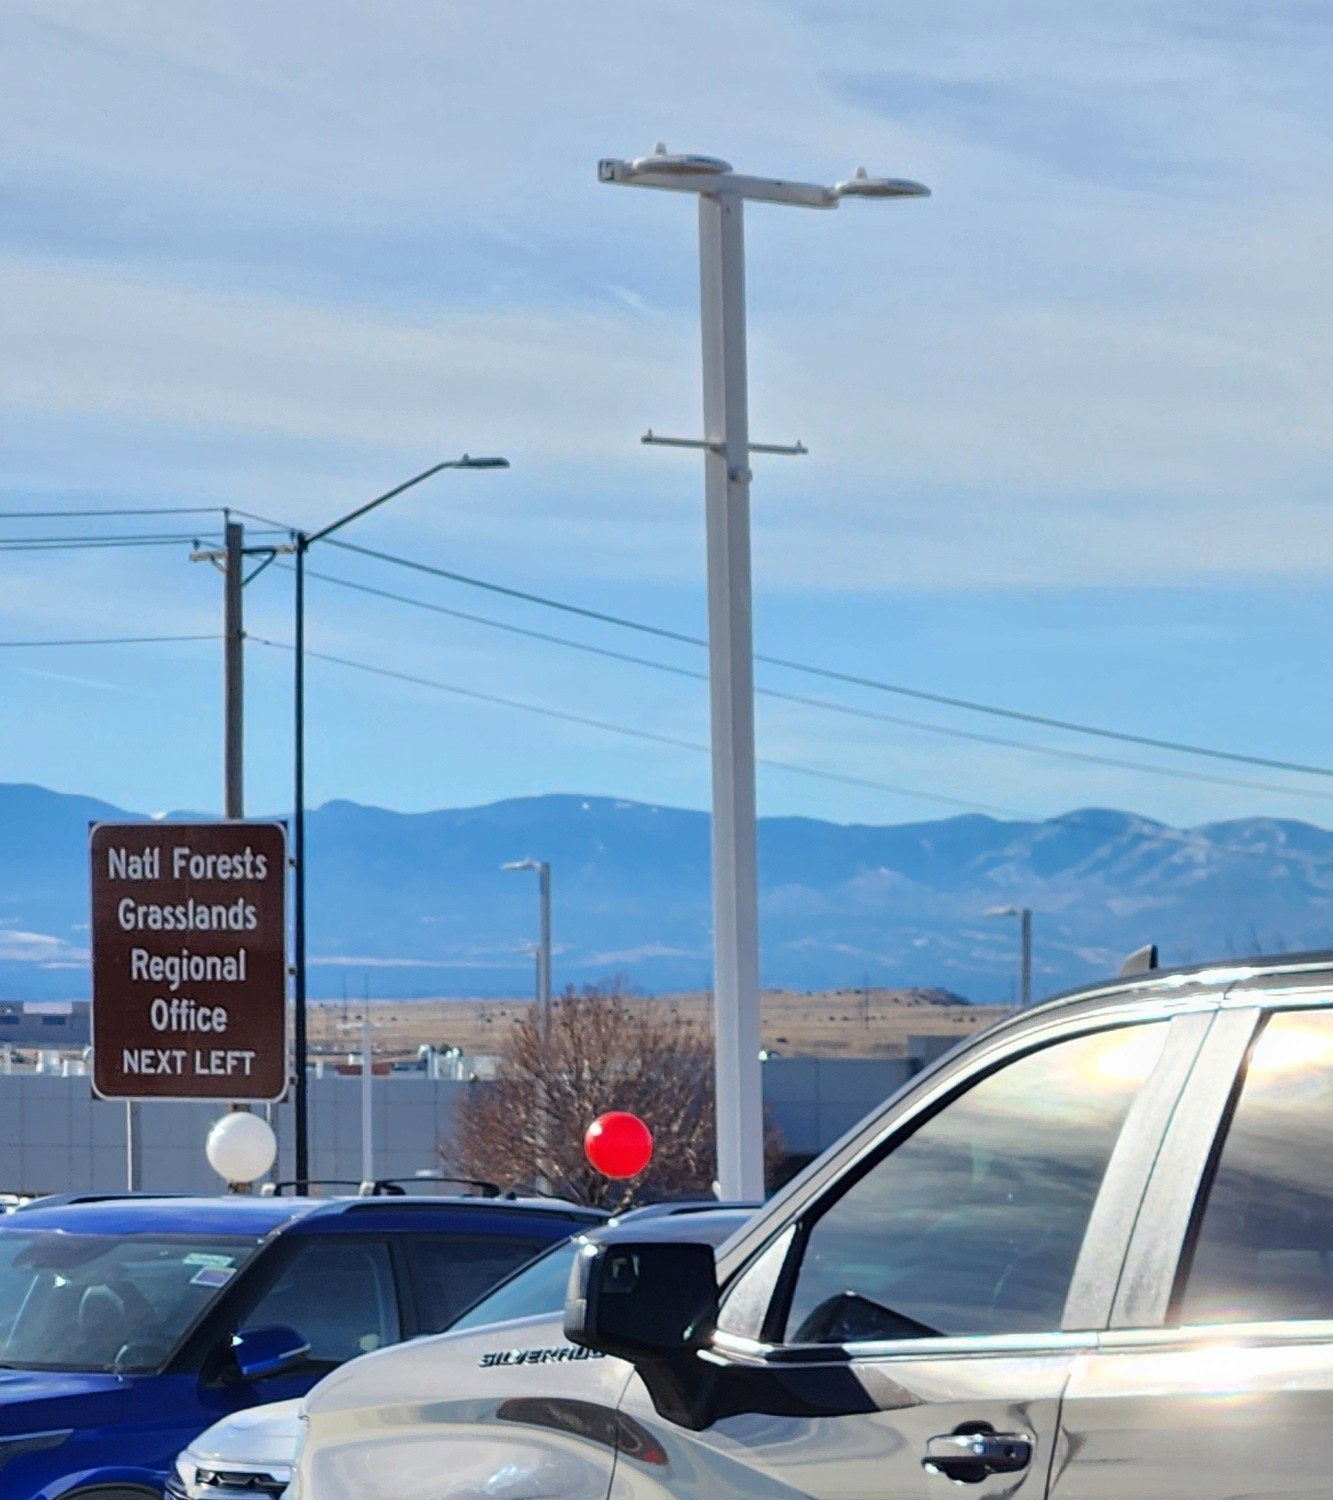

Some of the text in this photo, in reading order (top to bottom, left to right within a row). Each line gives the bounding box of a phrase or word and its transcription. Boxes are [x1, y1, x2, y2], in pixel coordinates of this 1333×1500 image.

[108, 848, 268, 880] Natl Forests
[118, 898, 258, 931] Grasslands
[131, 948, 246, 991] Regional
[151, 998, 228, 1033] Office
[123, 1050, 256, 1076] NEXT LEFT
